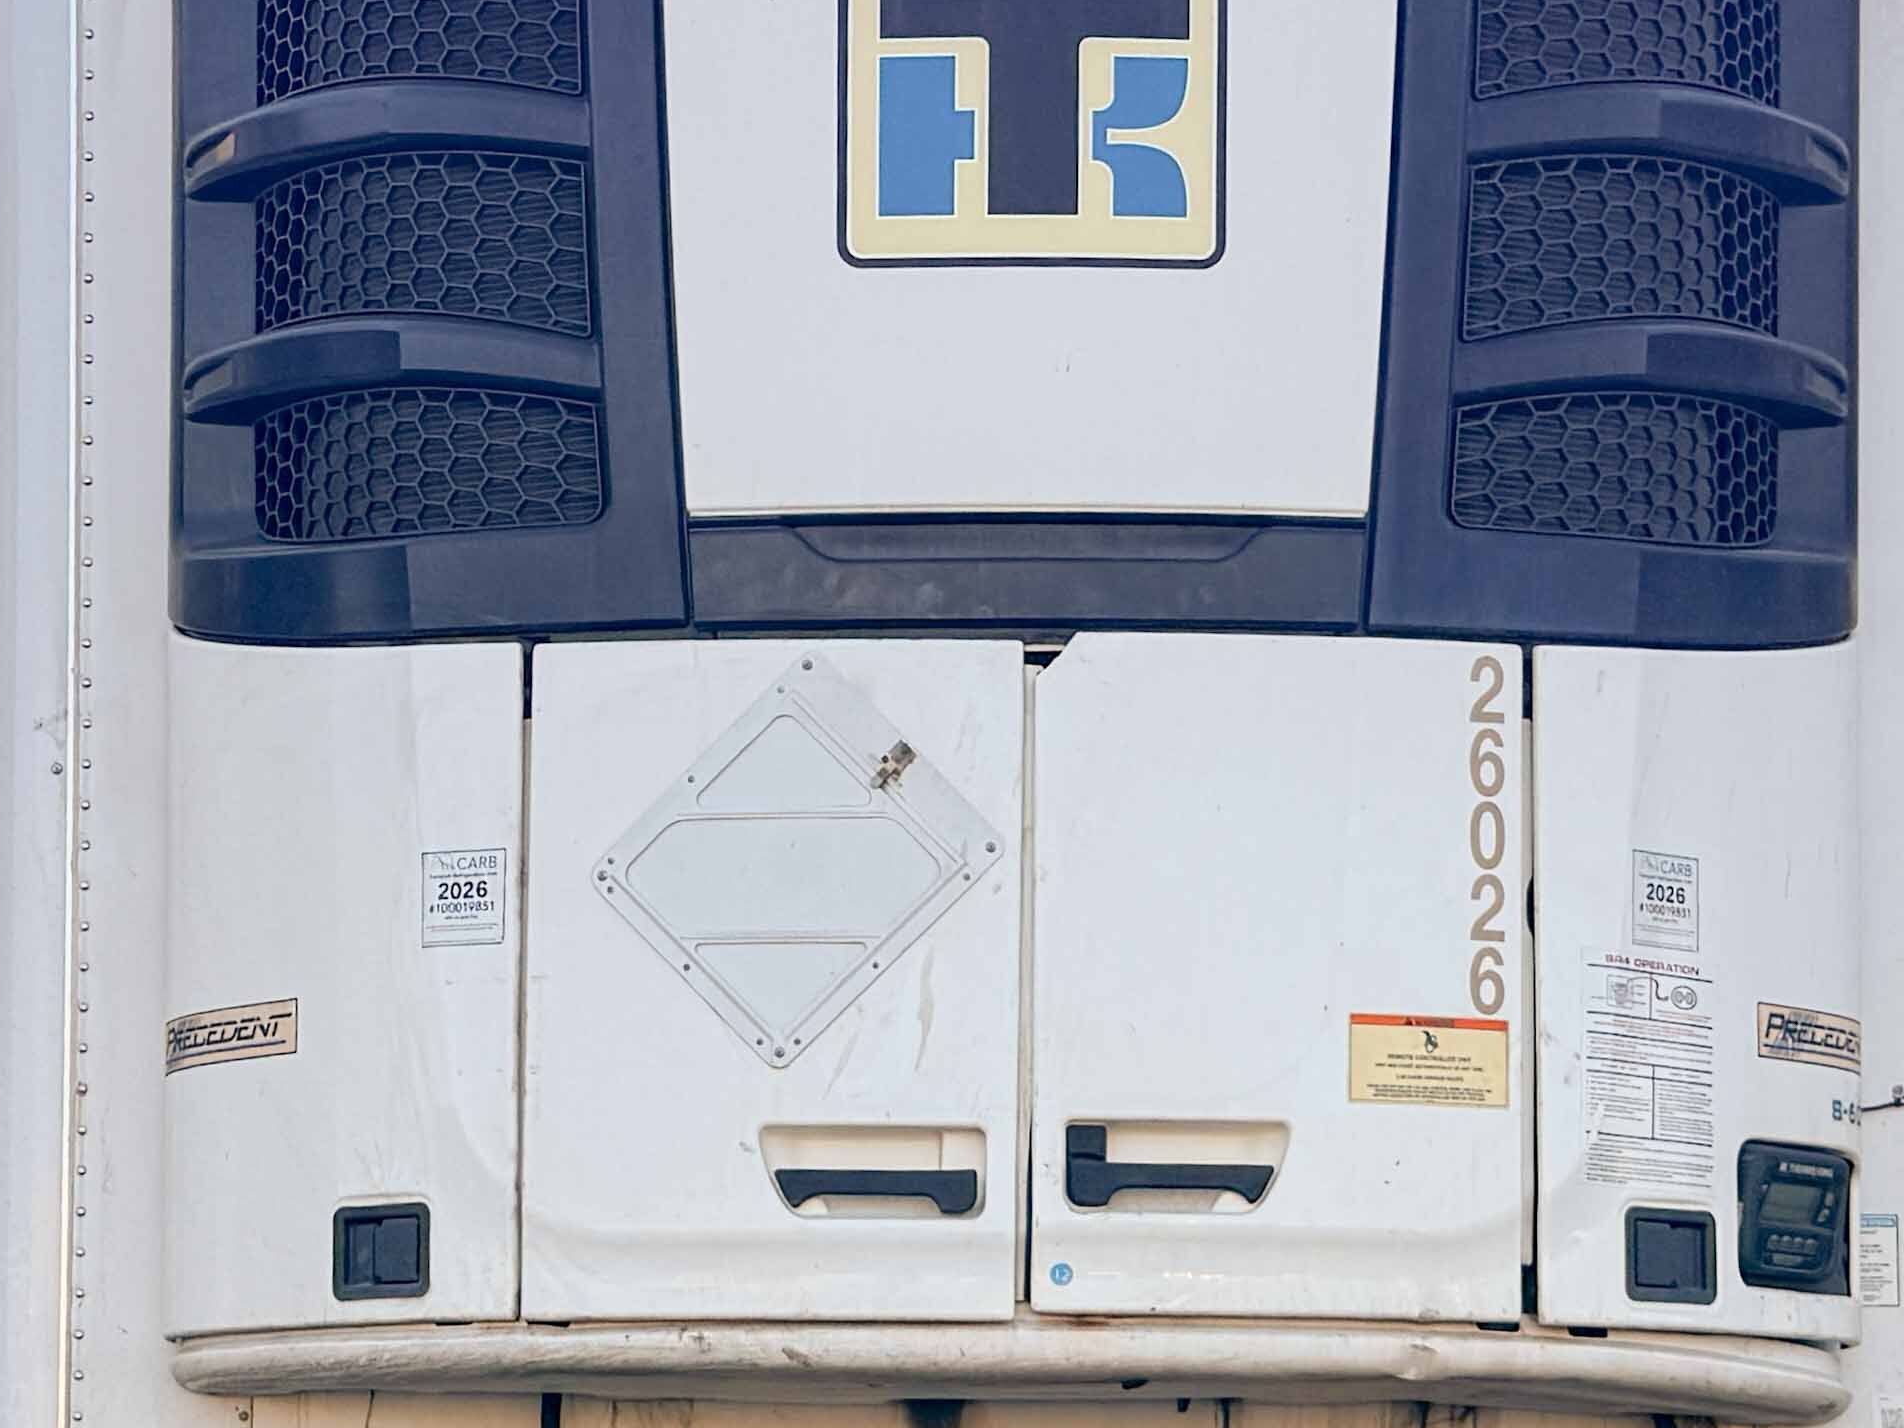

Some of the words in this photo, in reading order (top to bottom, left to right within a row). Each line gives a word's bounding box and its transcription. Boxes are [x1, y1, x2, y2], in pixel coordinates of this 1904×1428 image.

[1468, 655, 1505, 1015] 26026
[457, 855, 497, 870] CARB
[1661, 861, 1692, 877] CARB
[438, 880, 488, 900] 2026
[1646, 883, 1685, 904] 2026
